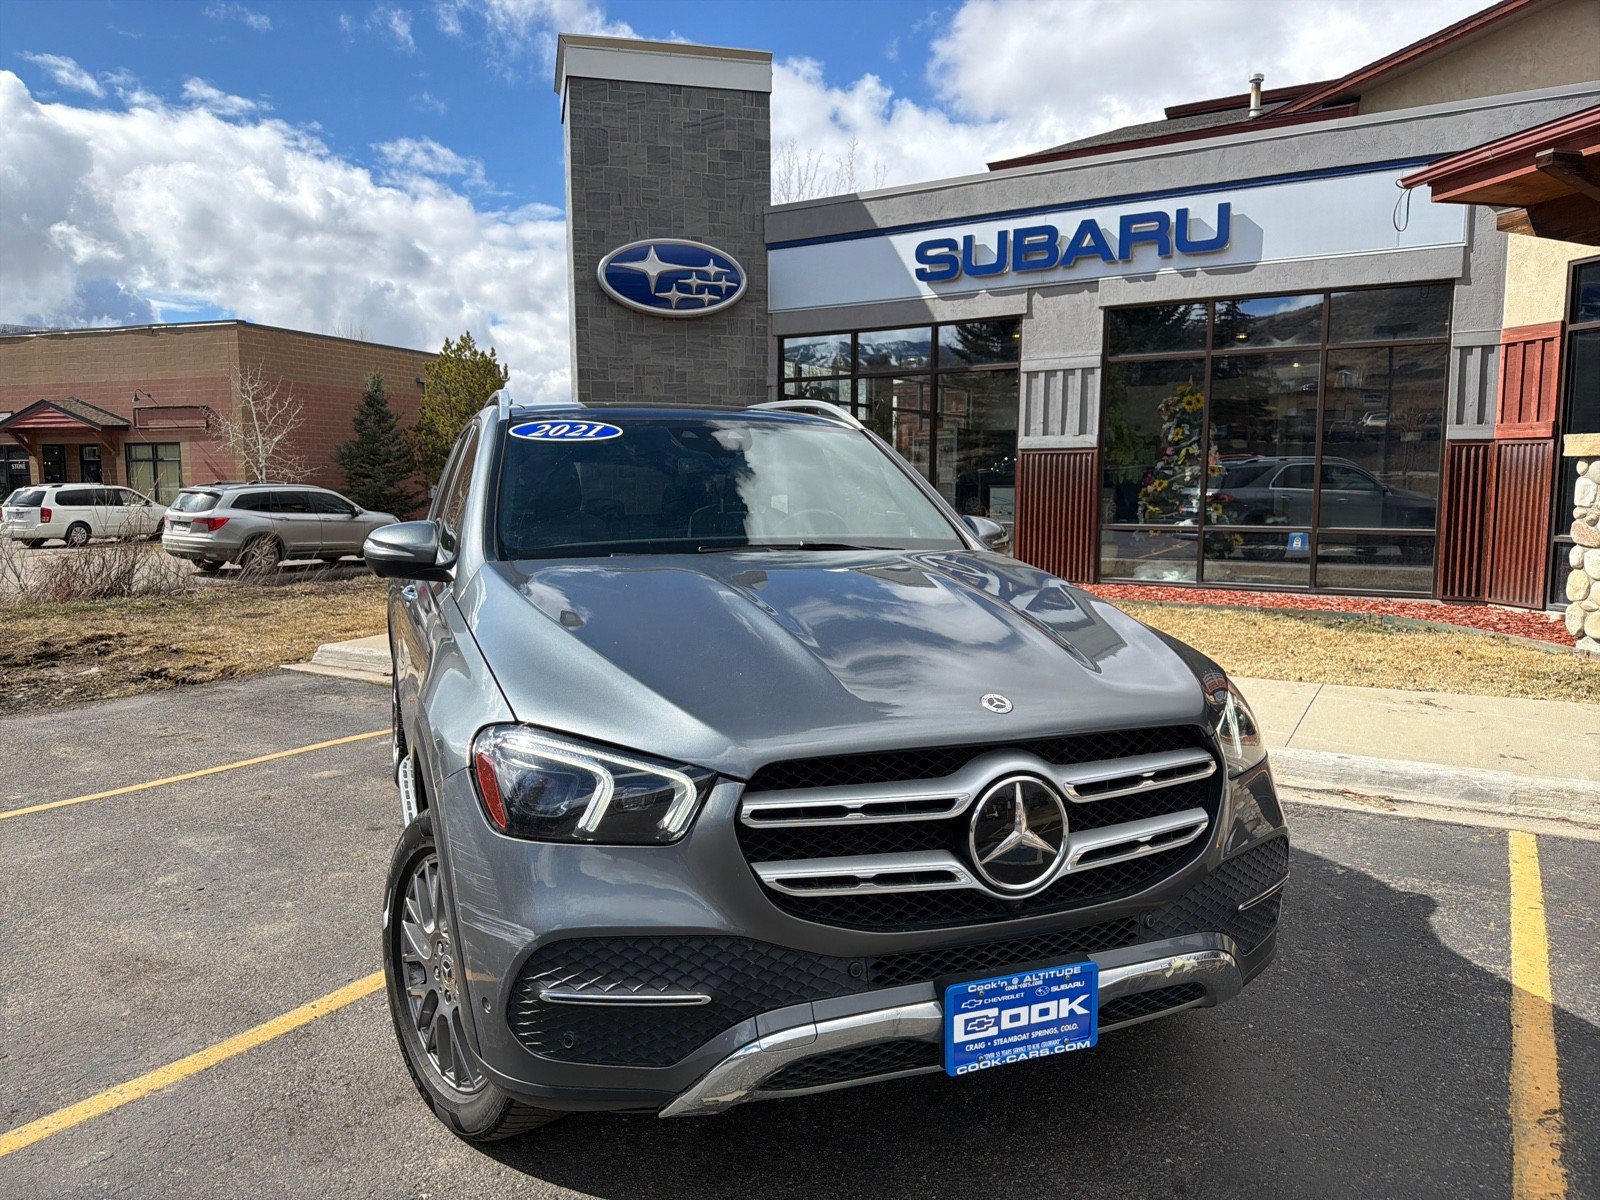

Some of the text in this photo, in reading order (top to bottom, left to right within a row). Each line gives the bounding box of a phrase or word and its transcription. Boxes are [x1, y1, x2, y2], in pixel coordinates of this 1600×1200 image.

[915, 202, 1231, 282] SUBARU
[528, 423, 605, 437] 2021
[968, 967, 1081, 992] Cook'n @ ALTITUDE
[1051, 981, 1085, 992] SUBARU
[984, 992, 1024, 1004] CHEVROLET
[954, 994, 1090, 1043] COOK
[966, 1041, 985, 1052] CRAIG
[993, 1032, 1029, 1046] STEAMBOAT
[1061, 1023, 1078, 1033] COLO.
[957, 1041, 1090, 1075] COOK-CARS.COM
